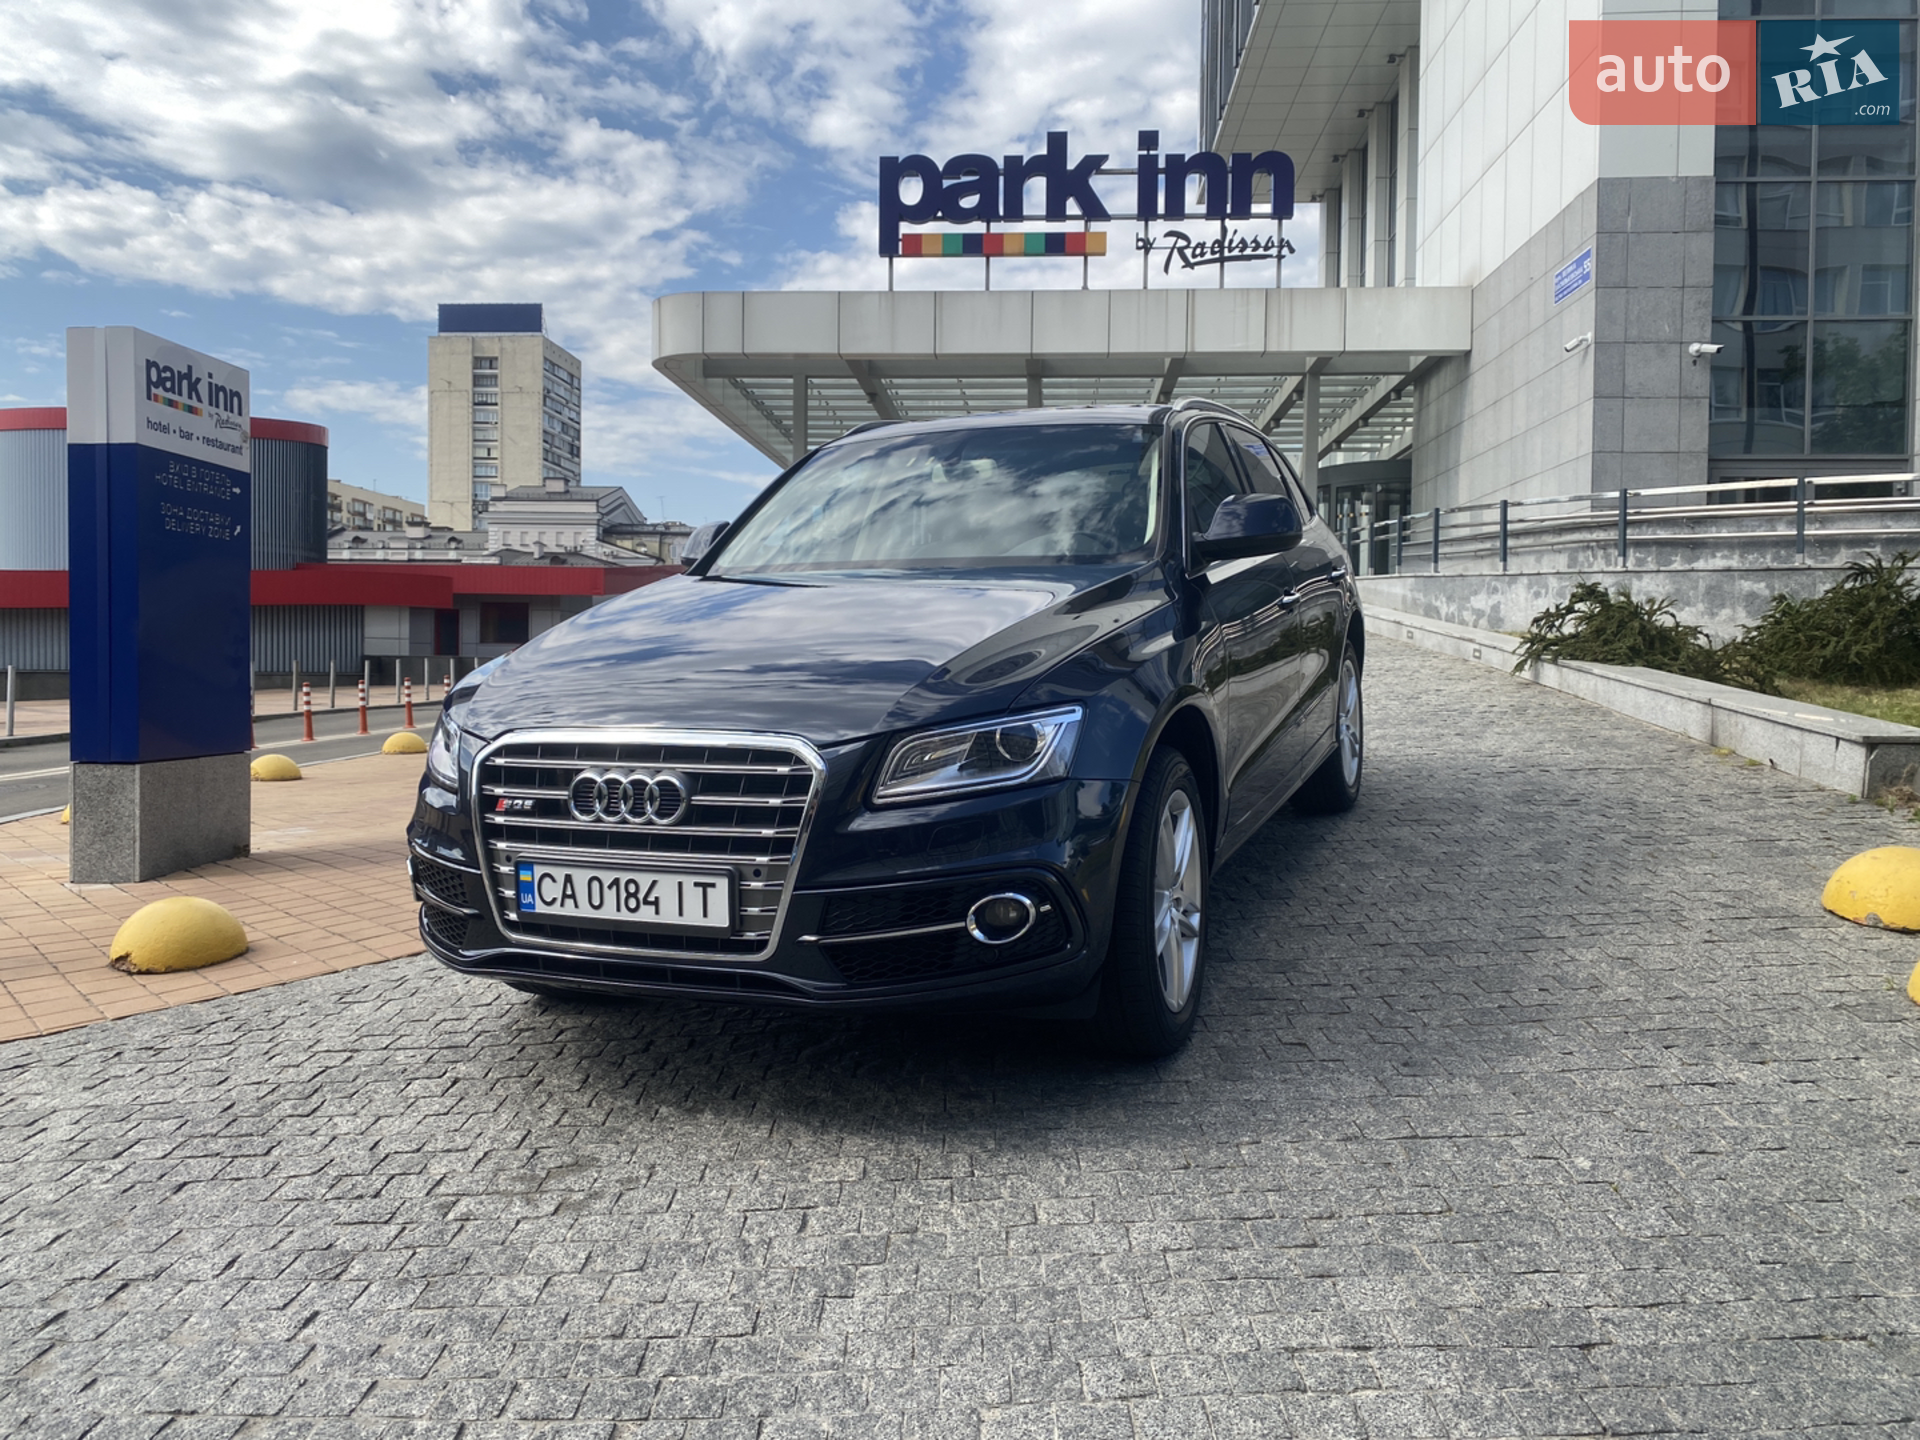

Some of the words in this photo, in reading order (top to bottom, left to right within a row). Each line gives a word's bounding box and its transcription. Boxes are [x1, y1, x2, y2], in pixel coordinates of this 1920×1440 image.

[879, 131, 1111, 257] park
[1138, 130, 1295, 221] inn
[1135, 232, 1157, 255] by
[1163, 222, 1296, 276] Radisson
[145, 358, 204, 404] park
[207, 371, 243, 417] inn
[146, 416, 171, 435] hotel
[178, 426, 194, 441] bar
[202, 436, 243, 456] restaurant
[155, 472, 184, 490] HOTEL
[186, 479, 232, 500] ENTRANCE
[208, 526, 231, 541] ZONE
[521, 893, 534, 905] UA
[537, 872, 579, 909] CA
[587, 875, 660, 916] 0184
[677, 880, 717, 919] IT
